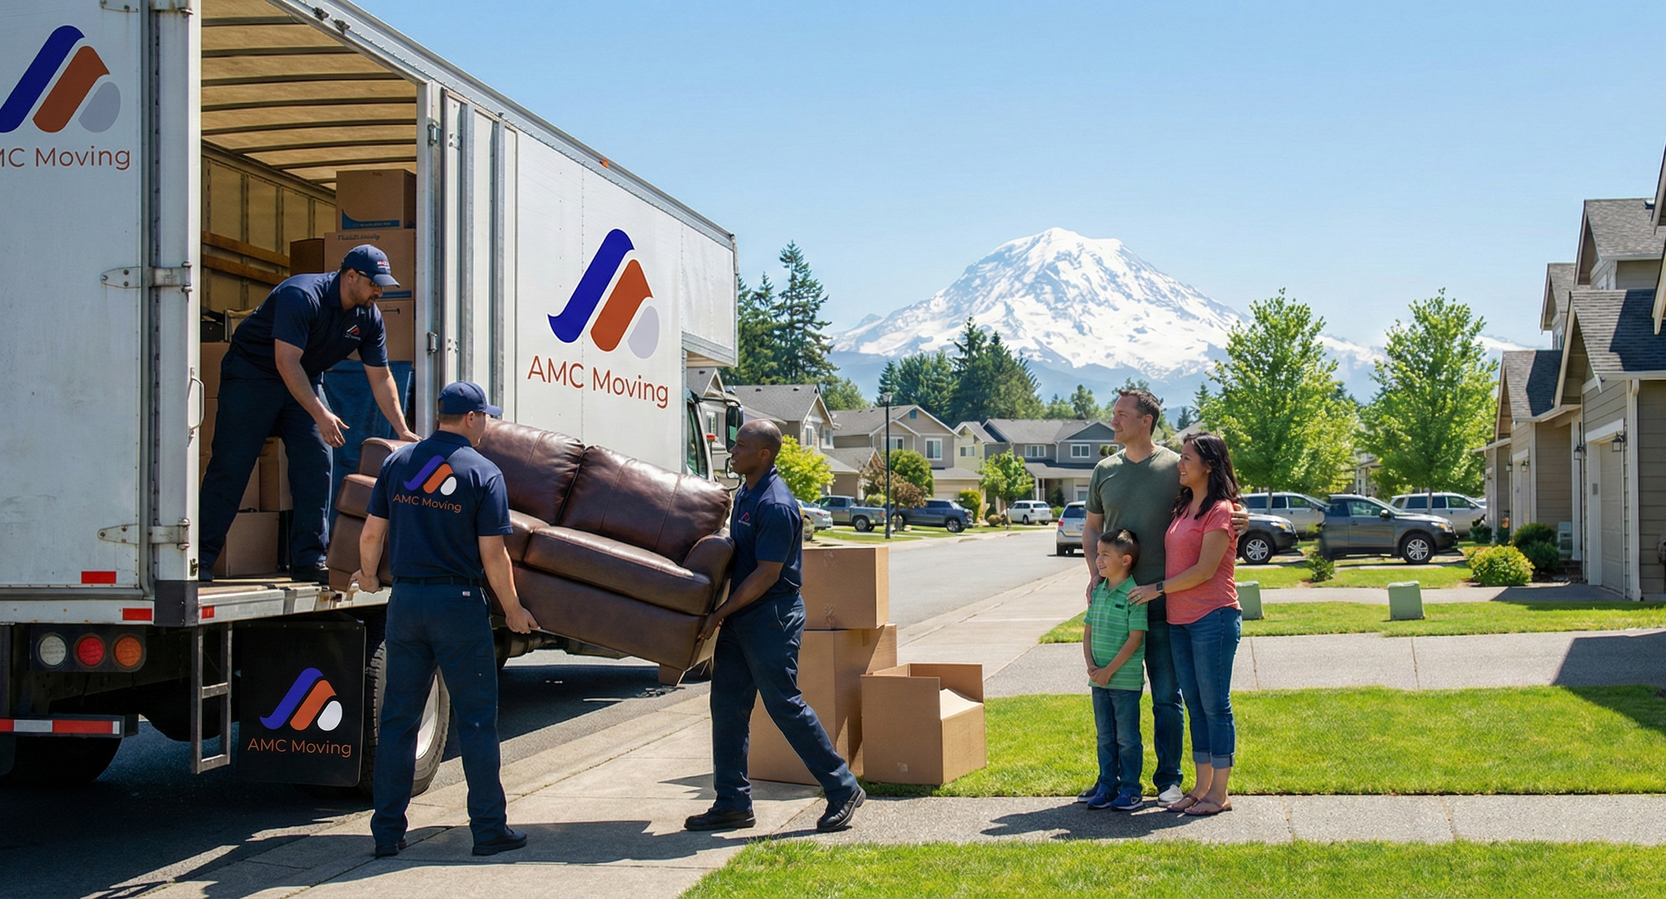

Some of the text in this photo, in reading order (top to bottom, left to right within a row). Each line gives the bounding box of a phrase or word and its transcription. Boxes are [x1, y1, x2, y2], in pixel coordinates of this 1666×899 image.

[0, 145, 131, 171] C Moving
[527, 355, 669, 409] AMC Moving
[392, 493, 462, 514] AMC Moving
[247, 738, 352, 758] AMC Moving
